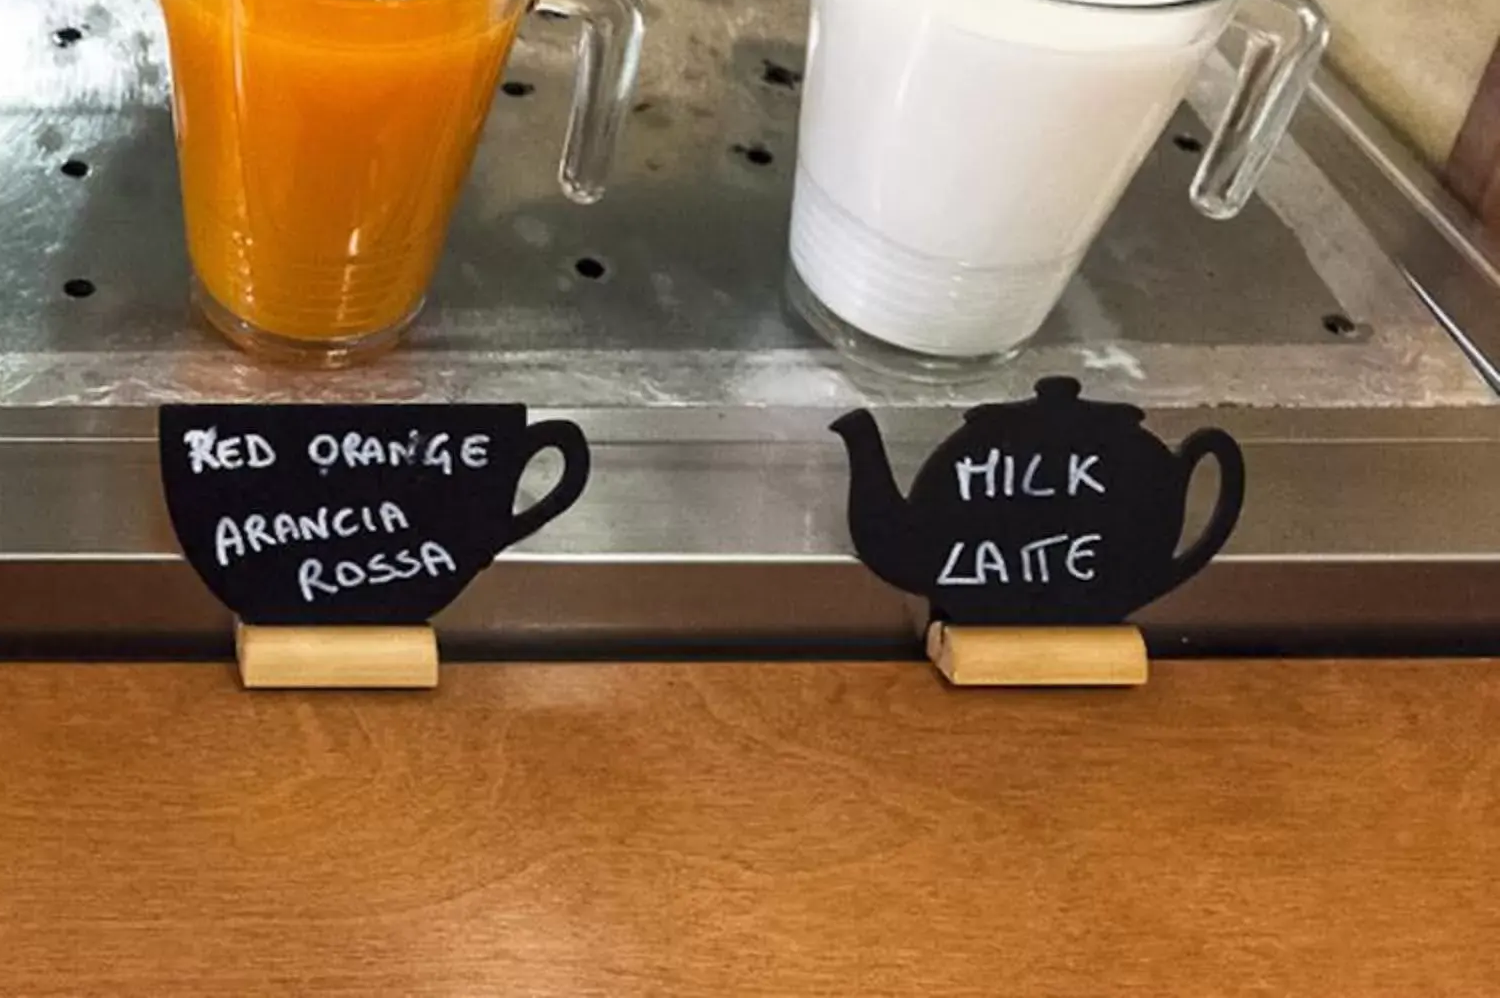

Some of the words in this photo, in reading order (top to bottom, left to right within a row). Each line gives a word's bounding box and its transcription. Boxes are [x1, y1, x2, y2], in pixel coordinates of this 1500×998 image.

[183, 426, 276, 474] RED
[307, 429, 491, 474] ORANGE
[955, 448, 1106, 500] MILK
[214, 501, 410, 565] ARANCIA
[298, 540, 457, 601] ROSSA
[937, 534, 1102, 585] LATTE
